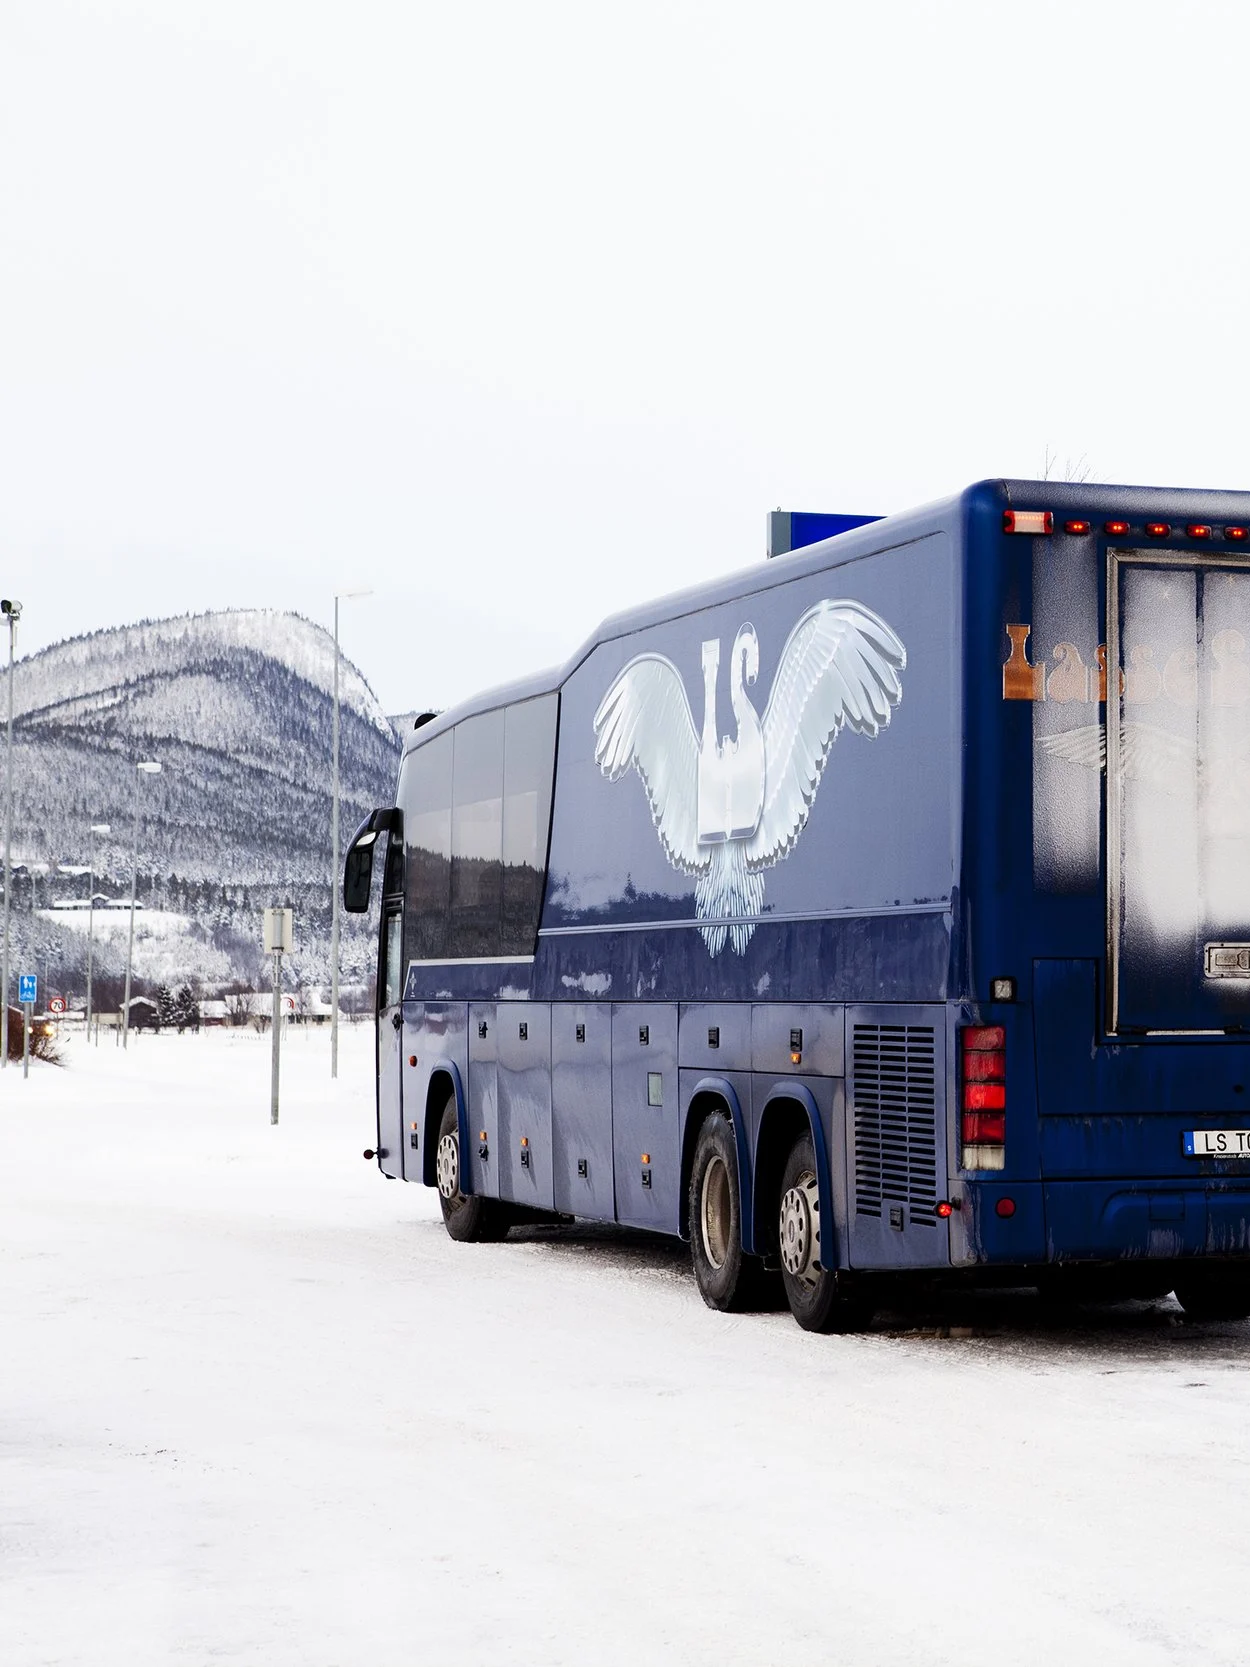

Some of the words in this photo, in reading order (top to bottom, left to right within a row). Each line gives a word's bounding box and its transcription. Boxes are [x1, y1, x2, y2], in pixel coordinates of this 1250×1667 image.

[1002, 623, 1198, 705] Lasse
[53, 1001, 63, 1009] 70
[1204, 1133, 1227, 1152] LS
